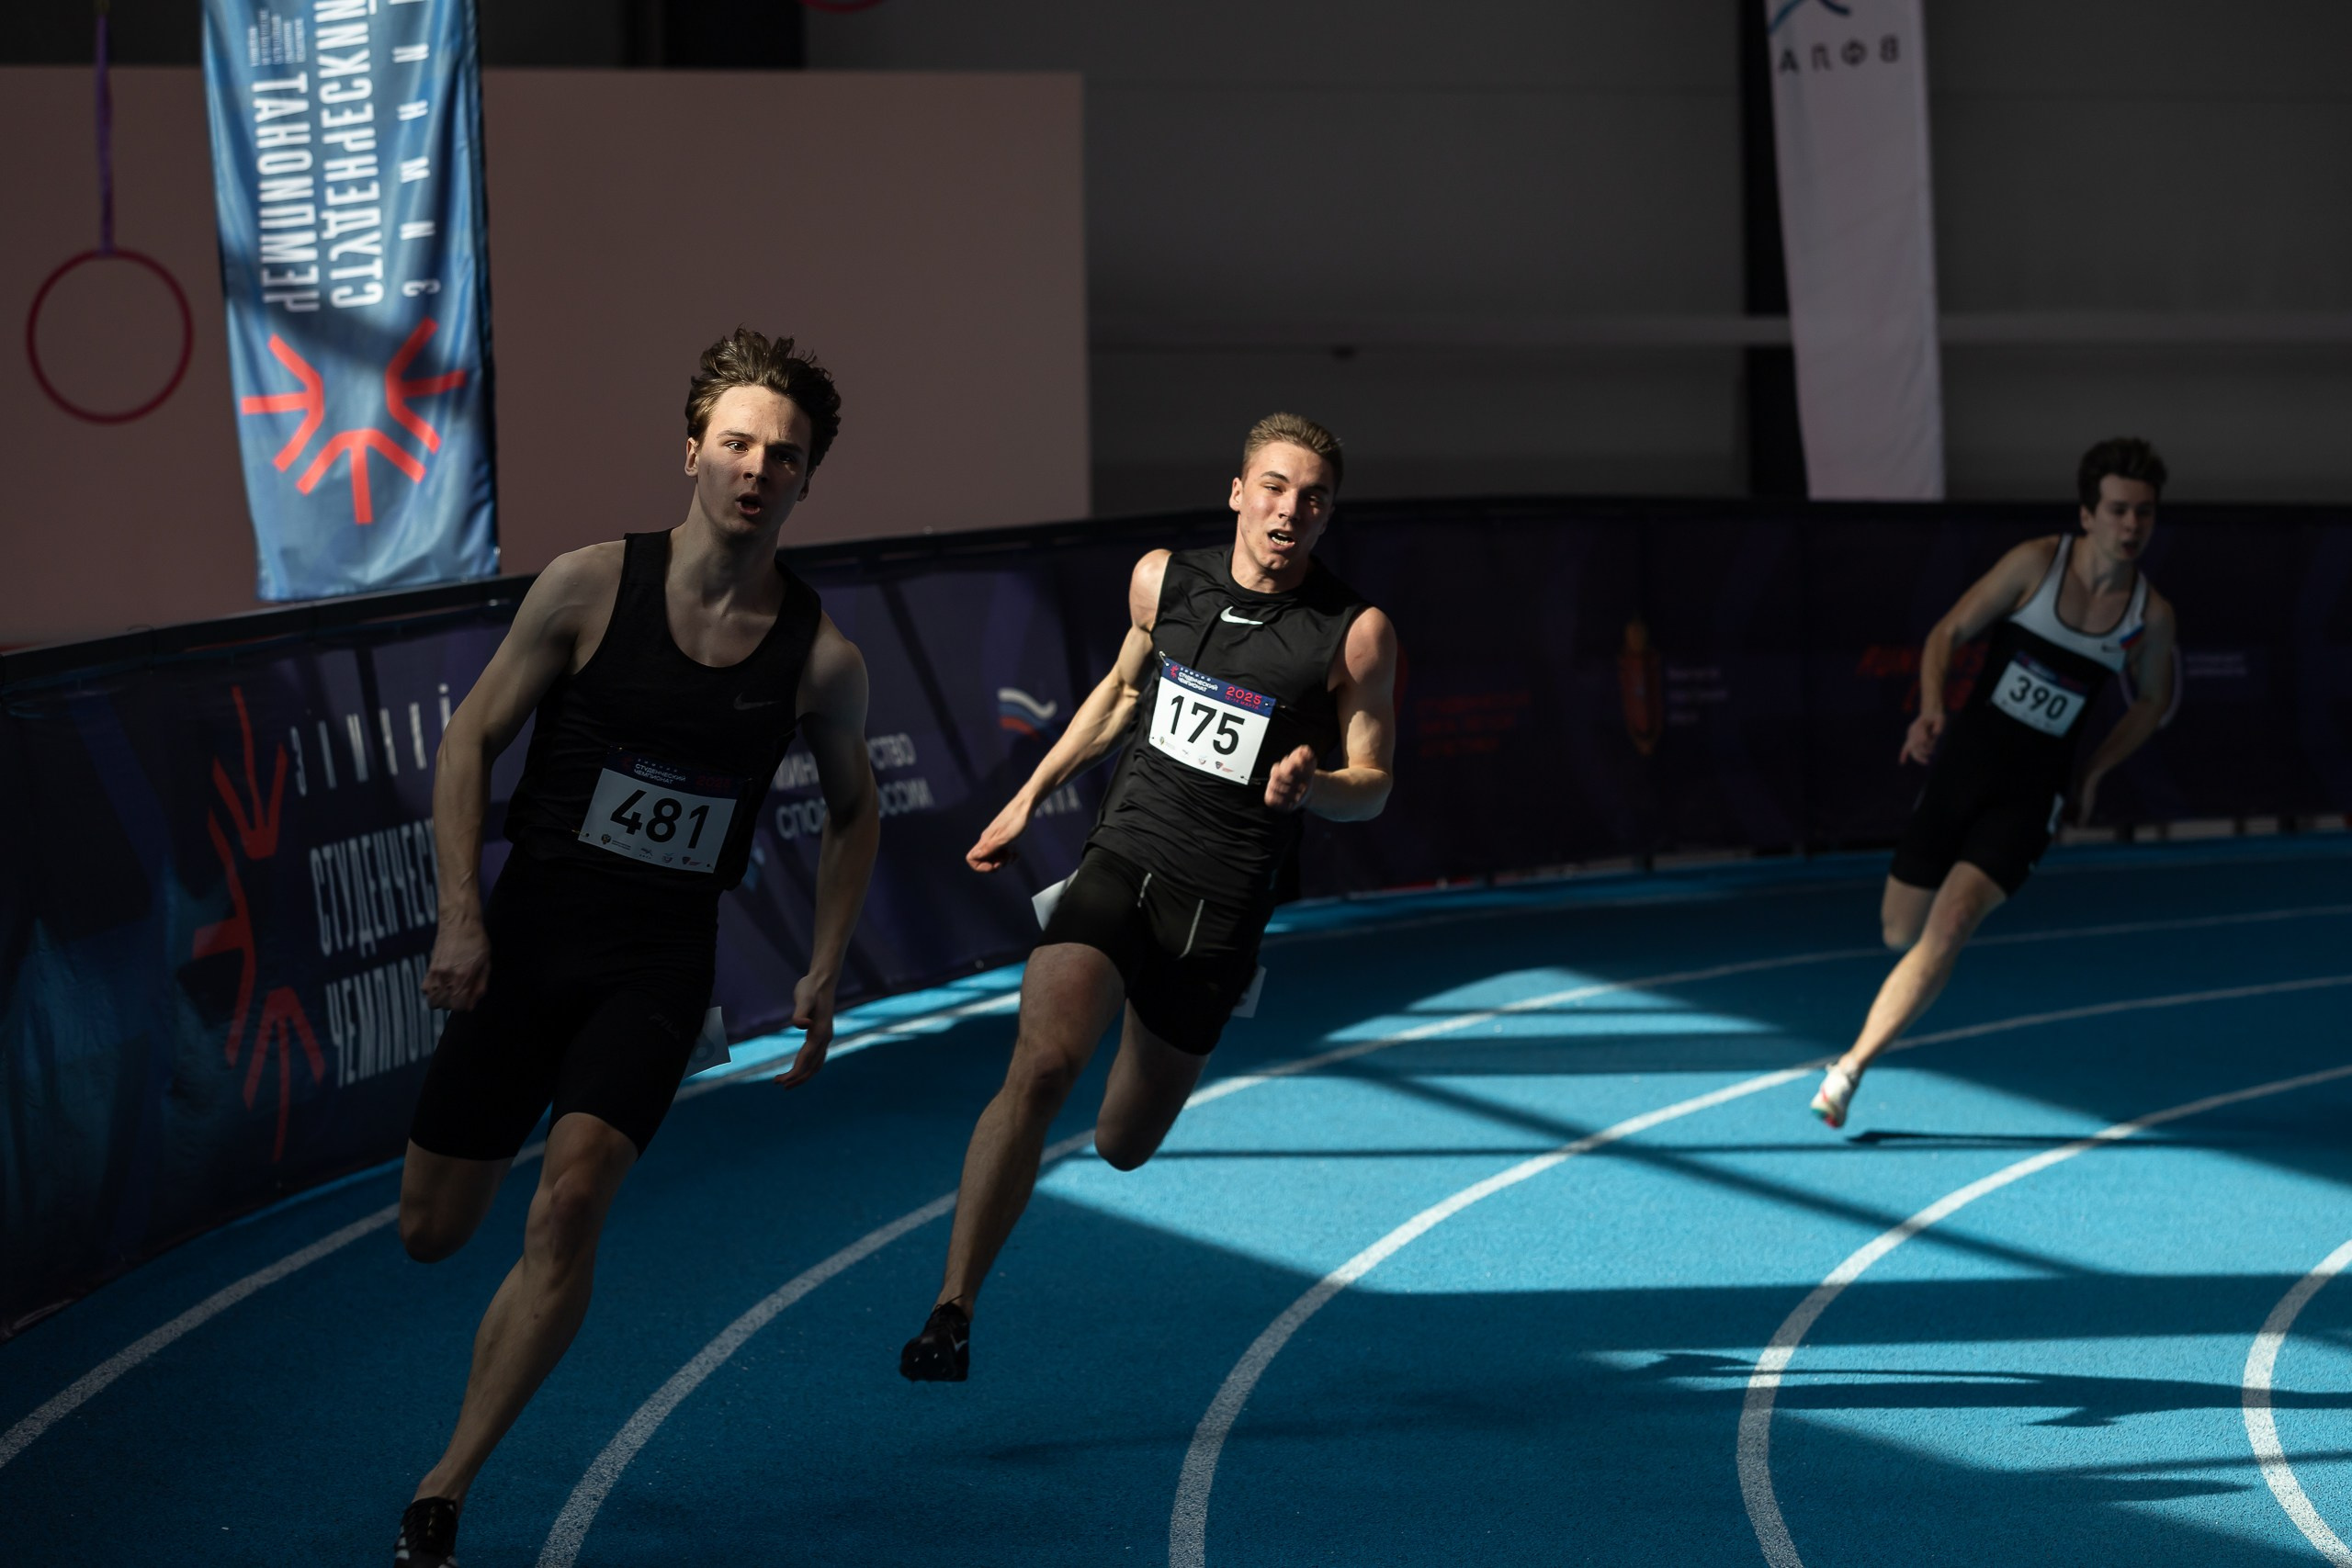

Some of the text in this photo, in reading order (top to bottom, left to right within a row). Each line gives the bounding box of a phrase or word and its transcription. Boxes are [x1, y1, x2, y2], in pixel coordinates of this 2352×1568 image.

[1225, 685, 1263, 706] 2025
[2009, 675, 2067, 719] 390
[1170, 694, 1246, 756] 175
[610, 789, 710, 849] 481
